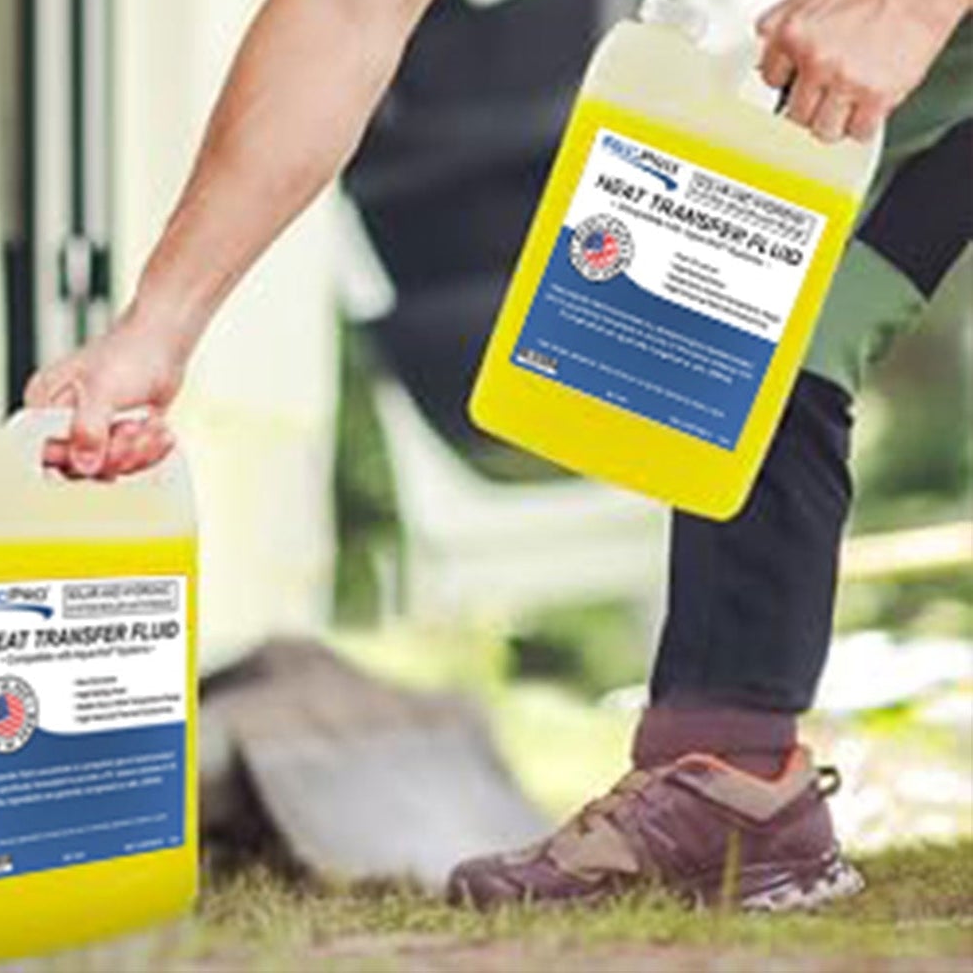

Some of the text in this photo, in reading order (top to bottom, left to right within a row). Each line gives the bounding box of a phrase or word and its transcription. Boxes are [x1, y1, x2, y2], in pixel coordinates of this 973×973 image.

[594, 174, 646, 204] HEAT
[652, 193, 748, 242] TRANSFER
[747, 231, 803, 266] FLUID
[34, 624, 128, 649] TRANSFER
[131, 620, 180, 641] FLUID
